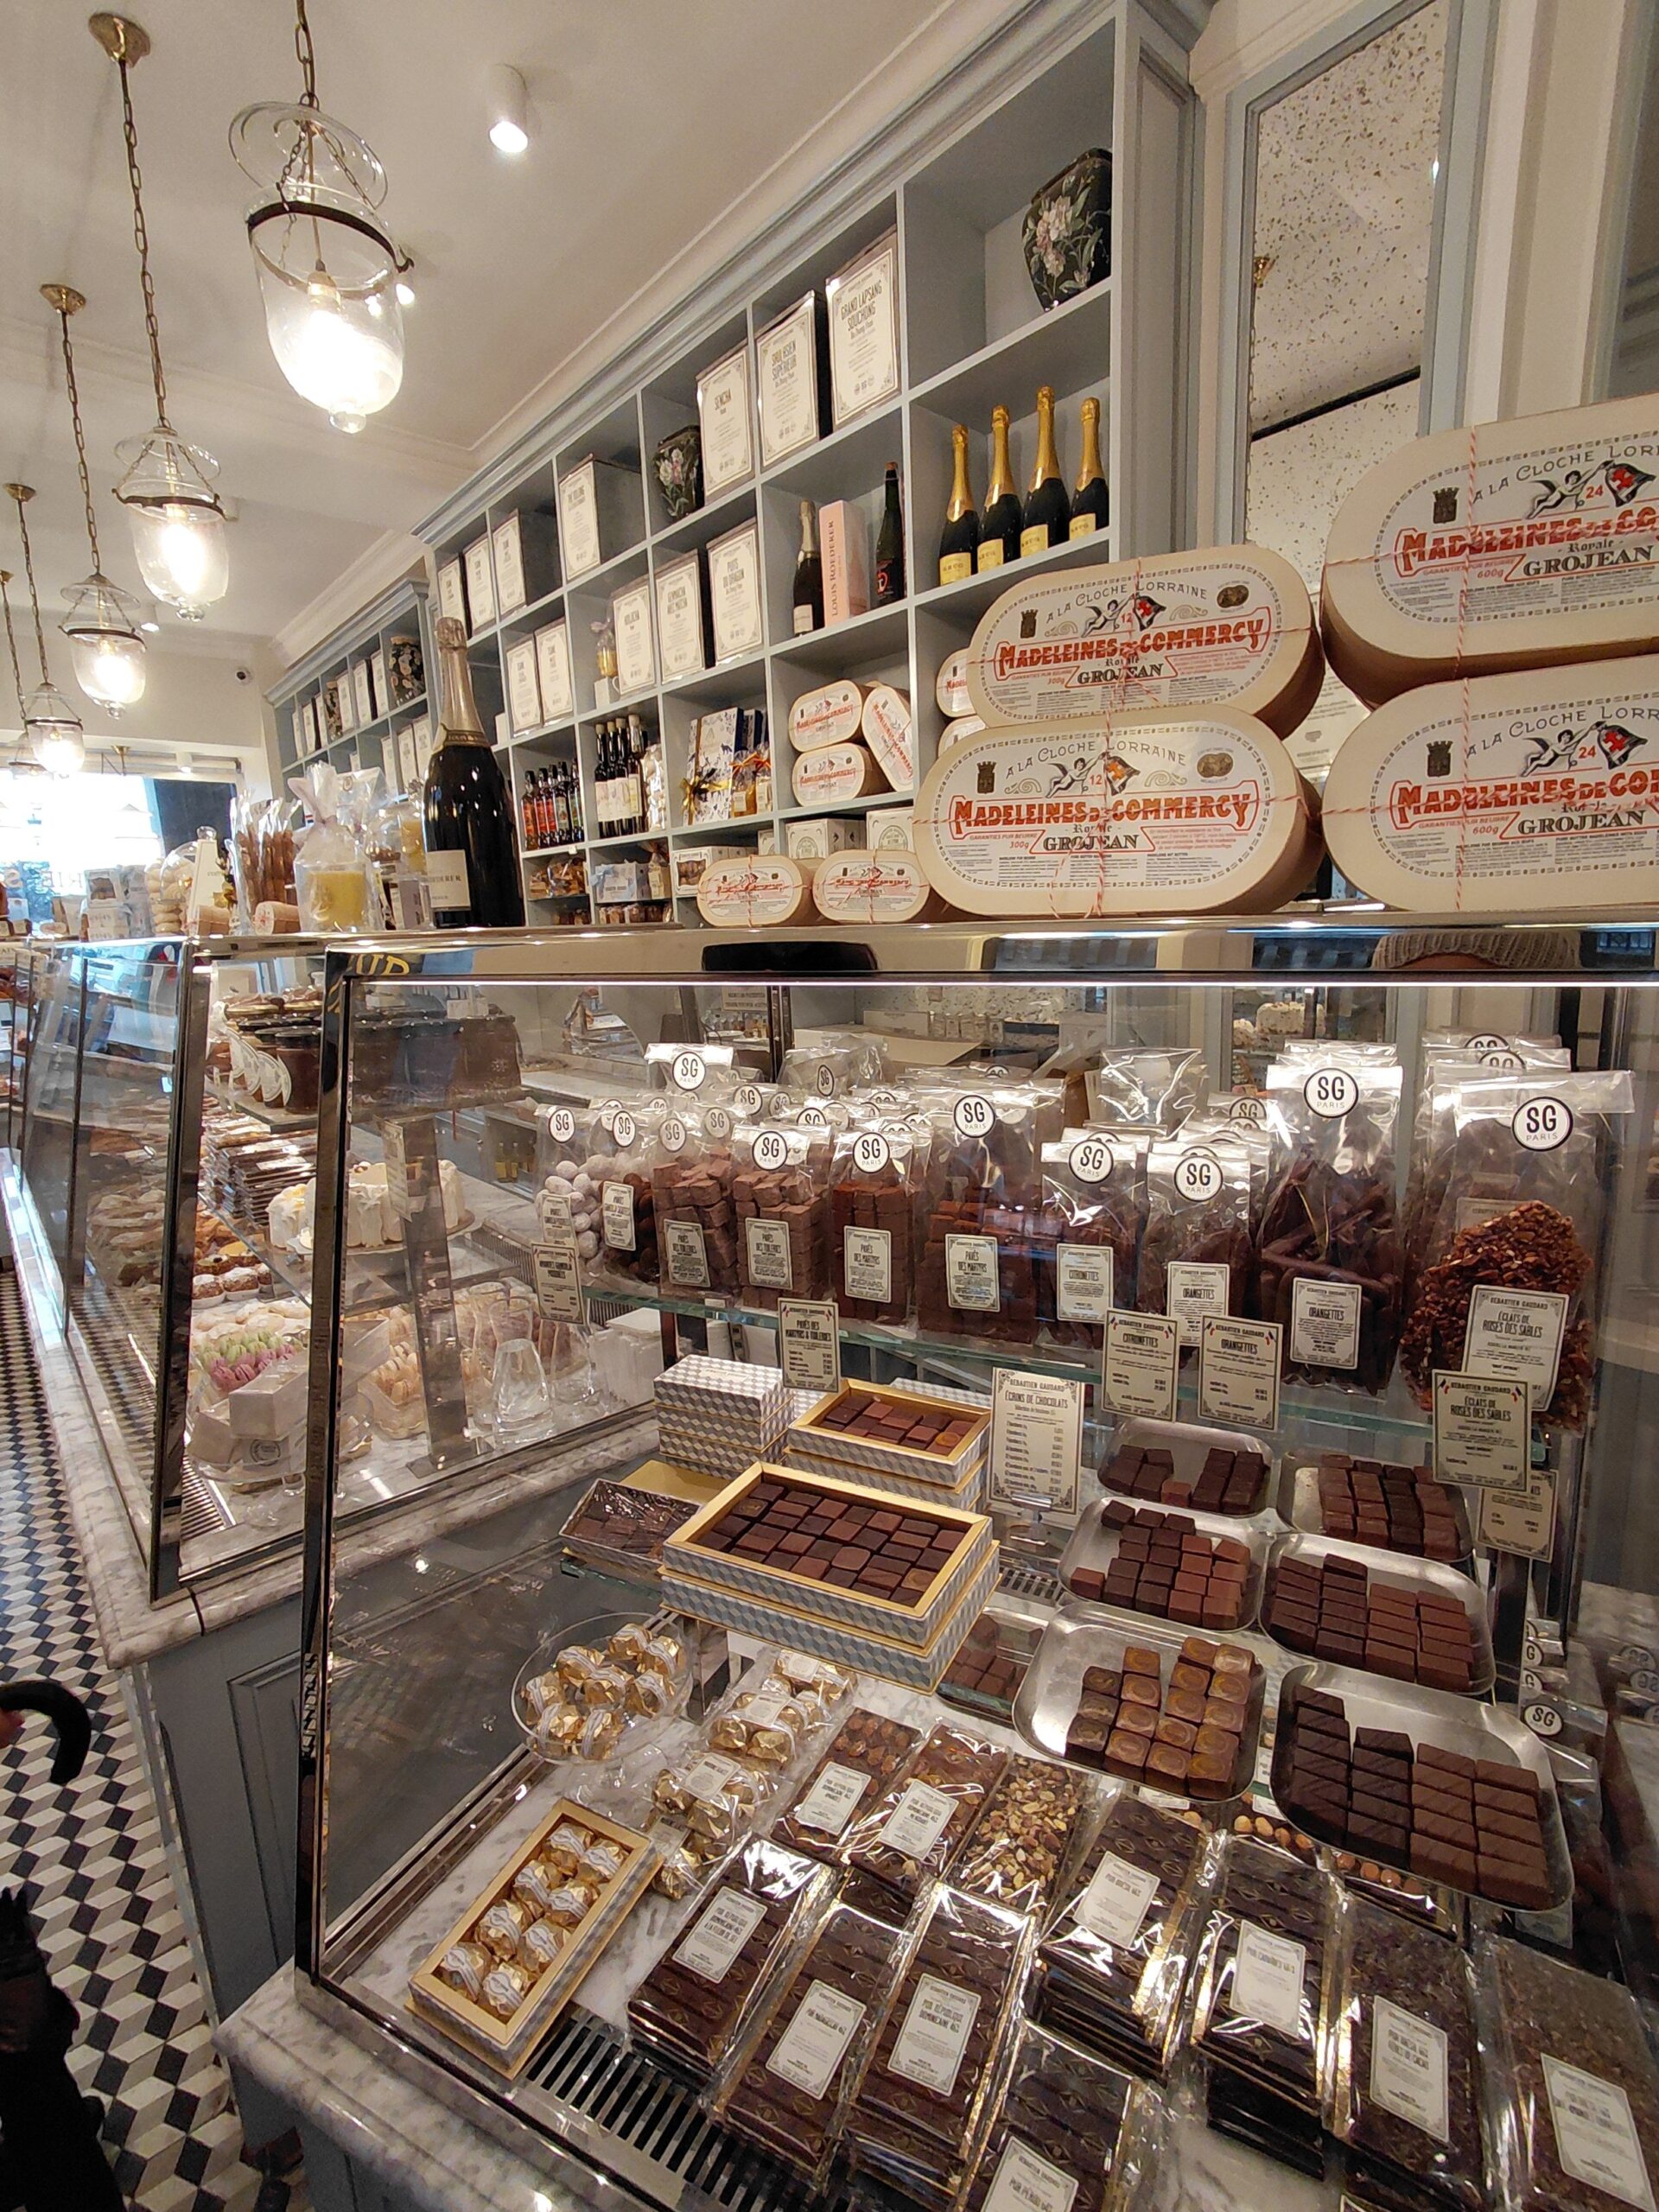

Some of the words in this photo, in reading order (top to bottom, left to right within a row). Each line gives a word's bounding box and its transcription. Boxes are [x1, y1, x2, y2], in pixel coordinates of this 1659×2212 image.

[1473, 490, 1484, 504] A
[1489, 477, 1510, 495] LA
[1516, 450, 1594, 481] CLOCHE
[1586, 485, 1604, 499] 24
[1403, 518, 1583, 573] MADELEINES
[1522, 545, 1654, 577] GROJEAN
[1477, 569, 1504, 580] 600g
[1046, 612, 1054, 624] A
[1057, 602, 1071, 617] LA
[1075, 584, 1128, 607] CLOCHE
[1136, 581, 1208, 601] LORRAINE
[999, 638, 1118, 677] MADELEINES
[1140, 619, 1264, 652] COMMERCY
[1466, 745, 1478, 759] A
[1481, 732, 1503, 751] LA
[1509, 710, 1587, 738] CLOCHE
[1005, 767, 1014, 779] A
[1017, 756, 1033, 772] LA
[1037, 741, 1097, 762] CLOCHE
[1107, 740, 1187, 766] LORRAINE
[1579, 745, 1597, 759] 24
[1089, 773, 1103, 786] 12
[1397, 776, 1576, 826] MADELEINES
[1579, 782, 1607, 800] DE
[955, 800, 1087, 835] MADELEINES
[1111, 793, 1251, 828] COMMERCY
[1517, 810, 1647, 836] GROJEAN
[1472, 825, 1499, 836] 600g
[681, 1057, 698, 1077] SG
[741, 1089, 756, 1105] SG
[1317, 1075, 1345, 1100] SG
[963, 1101, 985, 1123] SG
[1316, 1100, 1346, 1109] PARIS
[556, 1109, 569, 1131] SG
[618, 1116, 631, 1135] SG
[710, 1110, 725, 1128] SG
[1526, 1104, 1557, 1134] SG
[665, 1122, 680, 1141] SG
[1525, 1132, 1559, 1141] PARIS
[761, 1136, 779, 1158] SG
[861, 1138, 880, 1160] SG
[1079, 1145, 1104, 1170] SG
[1185, 1162, 1211, 1186] SG
[1182, 1287, 1215, 1300] ORANGETTES
[1308, 1306, 1344, 1321] ORANGETTES
[1522, 1314, 1530, 1325] DE
[1483, 1319, 1503, 1333] ROSES
[1504, 1322, 1517, 1335] DES
[1518, 1325, 1544, 1338] SABLES
[1221, 1338, 1259, 1356] ORANGETTES
[1039, 1382, 1065, 1392] GAUDARD
[1026, 1394, 1034, 1404] DE
[1035, 1395, 1069, 1409] CHOCOLATS
[1451, 1404, 1471, 1418] ROSES
[1472, 1407, 1486, 1419] DES
[1486, 1408, 1512, 1421] SABLES
[1532, 1707, 1555, 1727] SG
